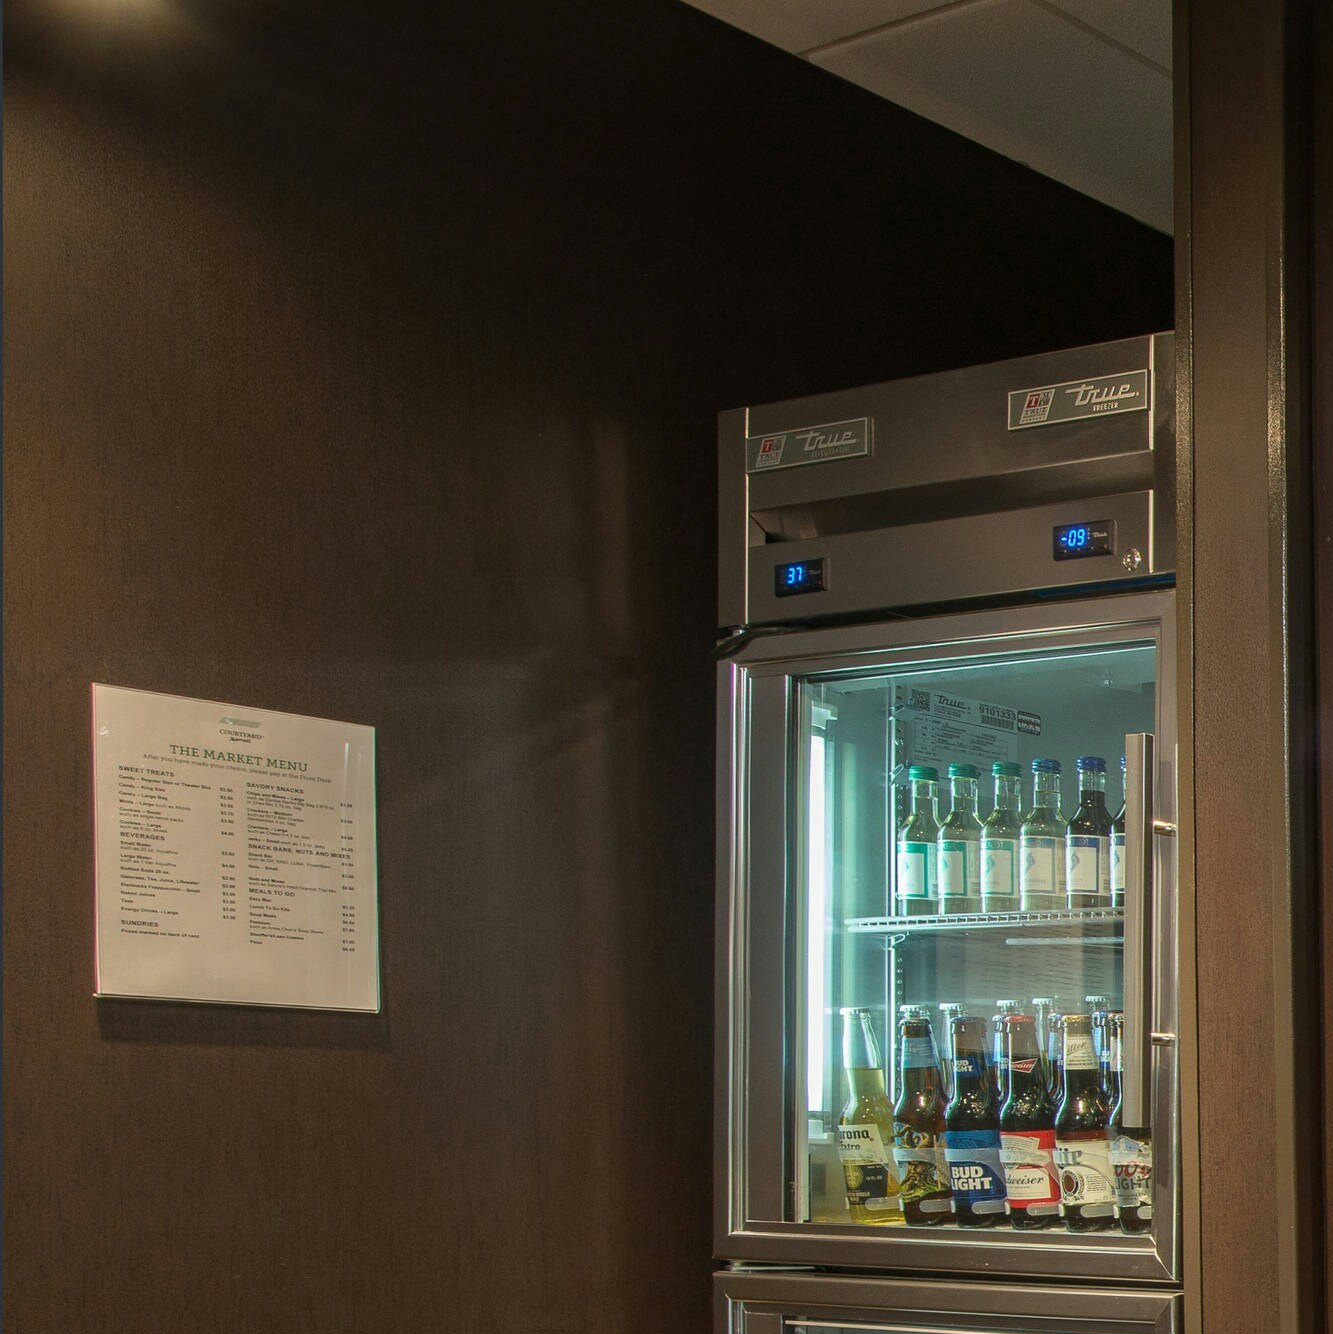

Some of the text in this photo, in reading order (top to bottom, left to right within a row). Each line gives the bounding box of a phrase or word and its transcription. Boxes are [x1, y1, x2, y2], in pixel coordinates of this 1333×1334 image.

[1092, 402, 1119, 412] FREEZER
[786, 566, 803, 583] 37
[219, 729, 263, 739] COURTYARD
[170, 744, 308, 772] THE MARKET MENU
[118, 766, 175, 777] SWEET TREATS
[246, 782, 304, 794] SAVORY SNACKS
[120, 831, 165, 841] BEVERAGES
[121, 919, 159, 927] SUNDRIES
[952, 1167, 983, 1178] BUD
